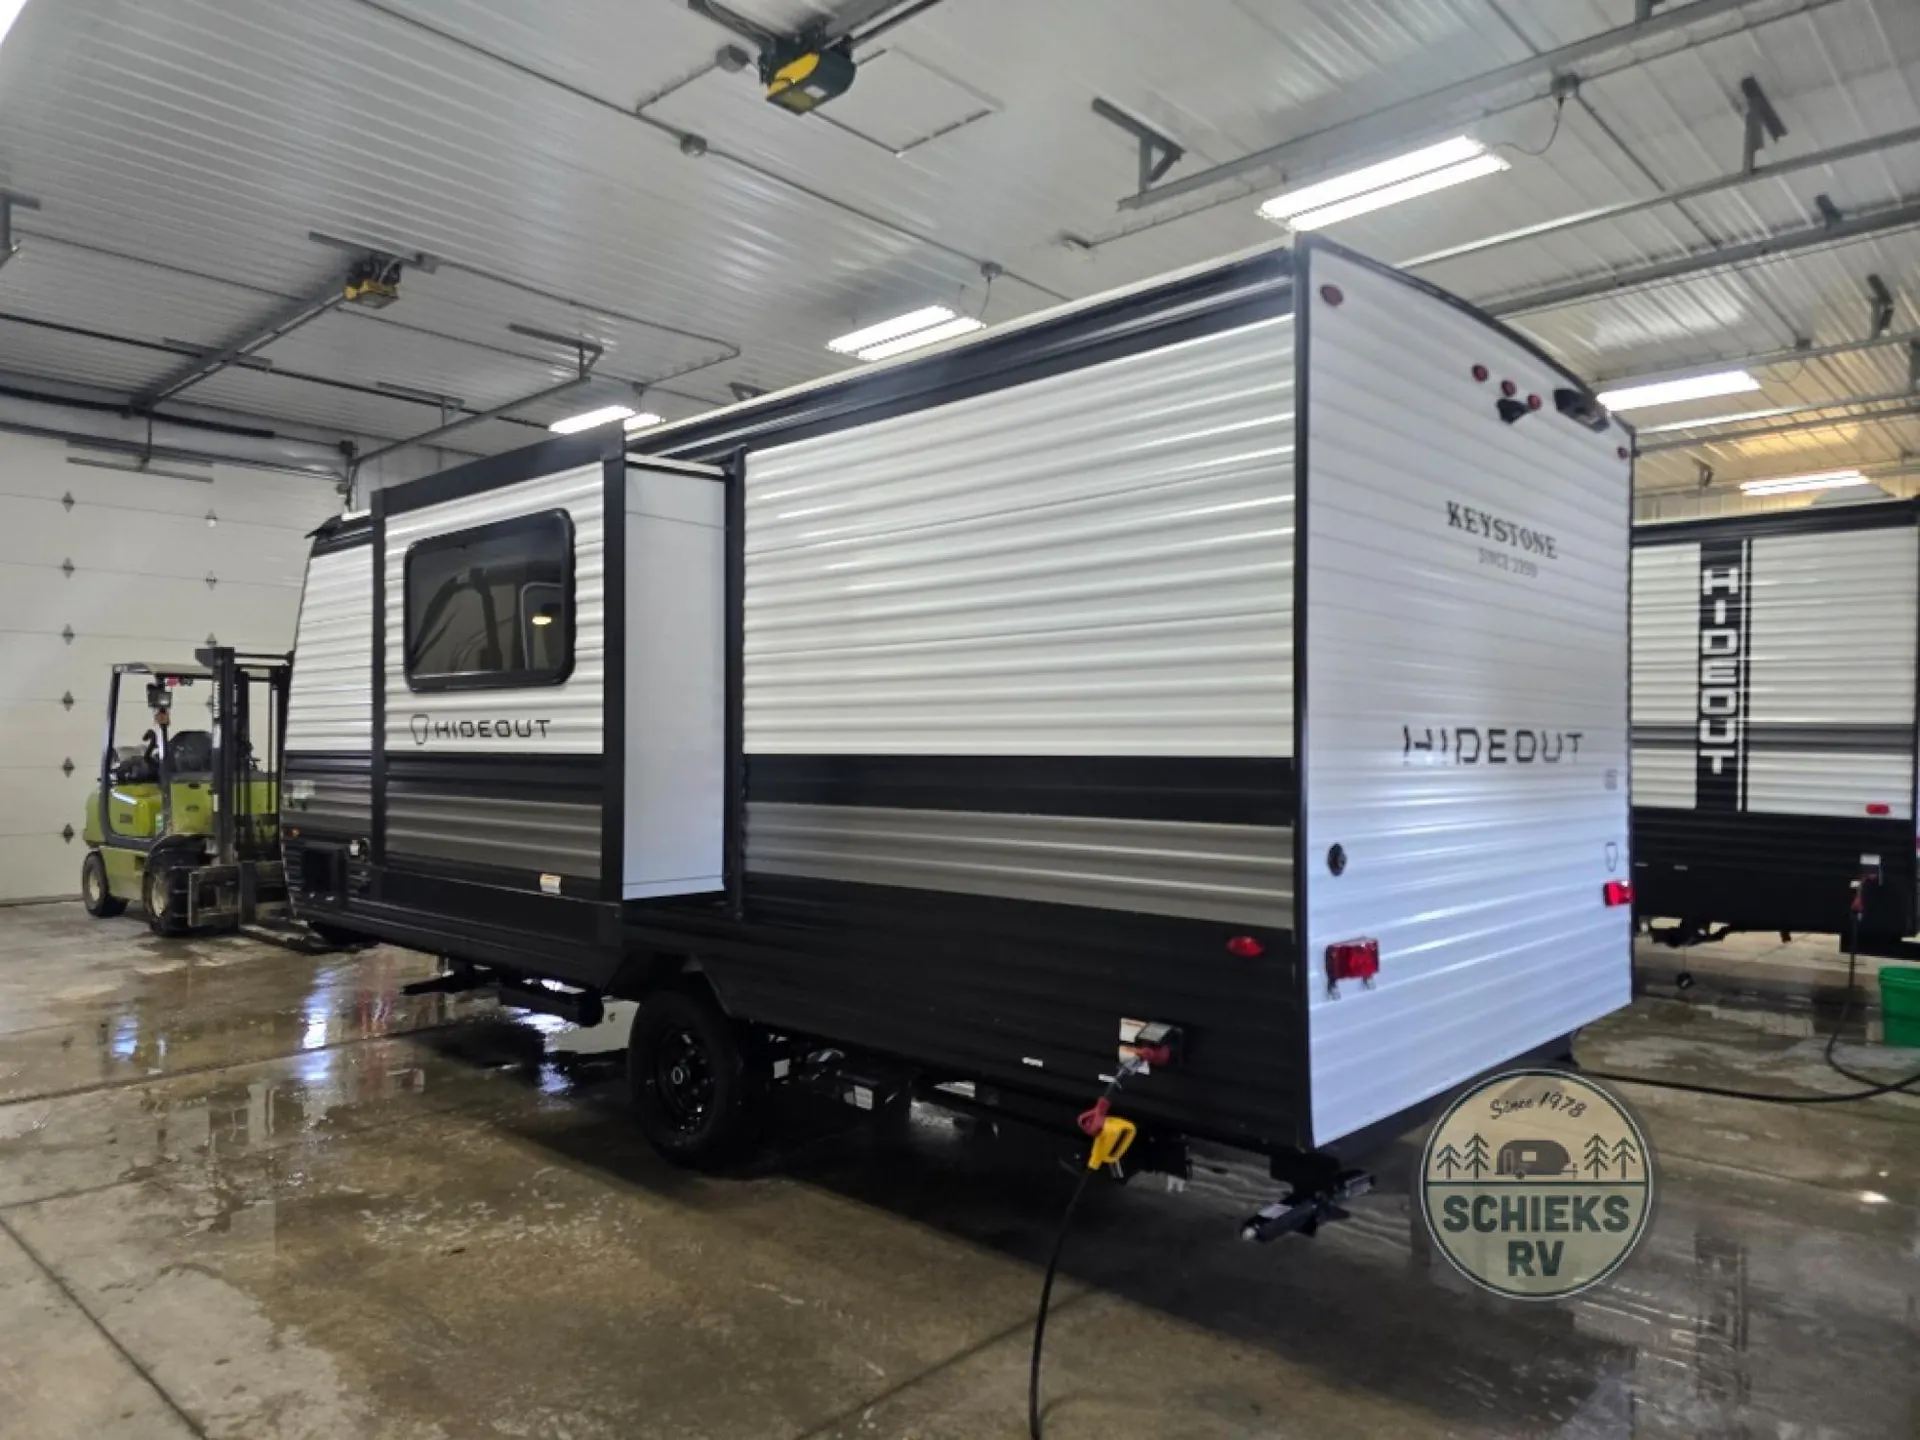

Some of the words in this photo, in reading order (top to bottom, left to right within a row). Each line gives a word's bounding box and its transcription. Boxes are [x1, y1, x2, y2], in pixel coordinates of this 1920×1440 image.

[1446, 499, 1558, 560] KEYSTONE
[1702, 567, 1739, 775] HIDEOUT
[434, 719, 551, 738] HIDEOUT
[1403, 725, 1583, 765] HIDEOUT
